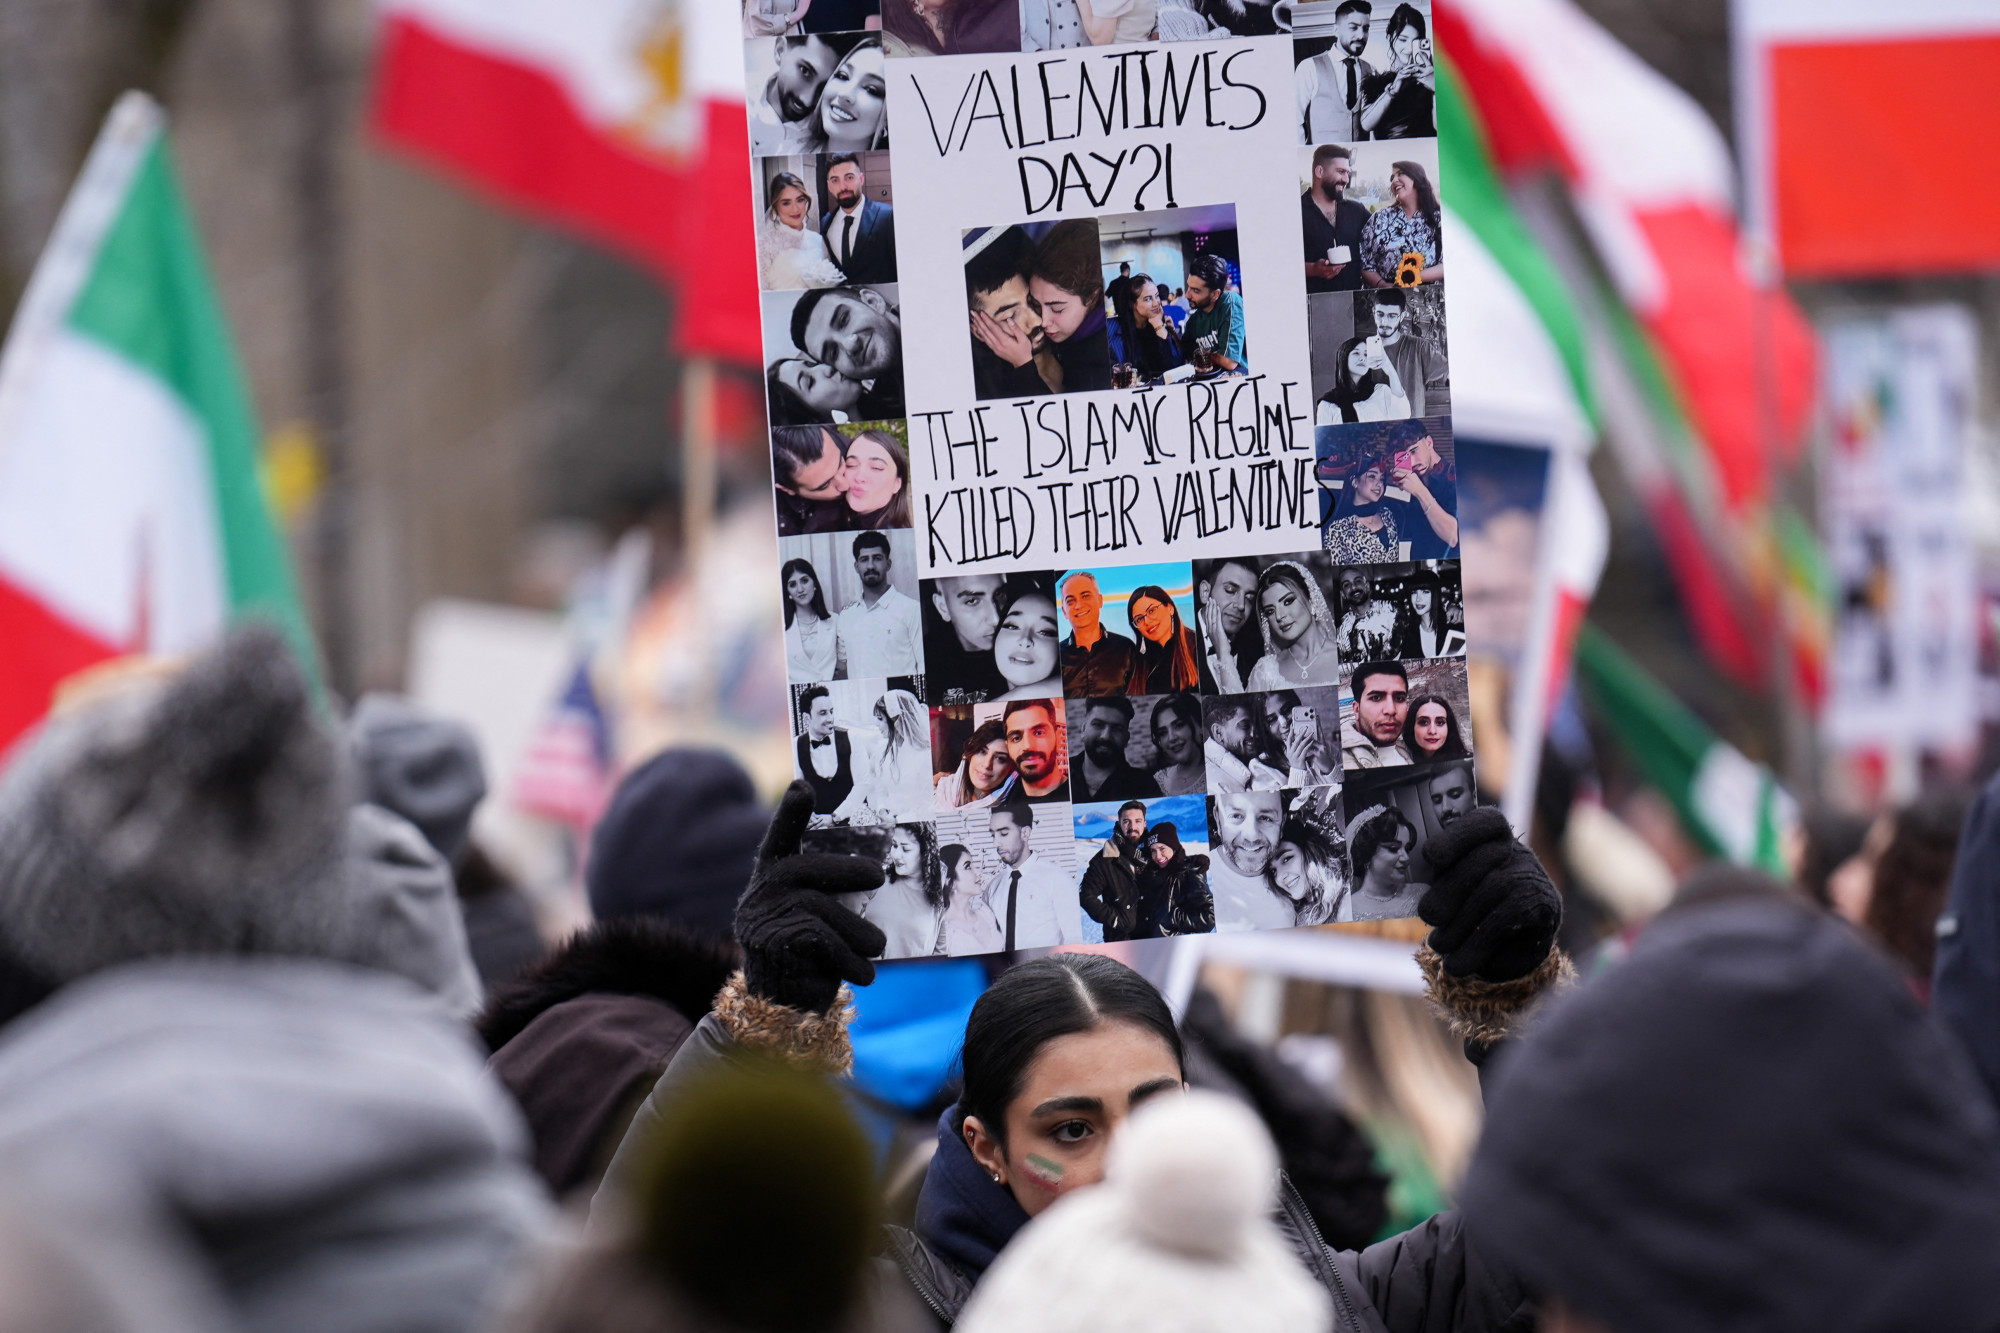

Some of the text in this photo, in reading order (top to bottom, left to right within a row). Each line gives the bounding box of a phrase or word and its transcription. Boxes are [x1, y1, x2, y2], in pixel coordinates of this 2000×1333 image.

[911, 48, 1266, 157] VALENTINES
[1018, 143, 1178, 215] DAY?!
[912, 374, 1309, 480] THE ISLAMIC REGIME
[925, 457, 1336, 568] KILLED THEIR VALENTINES
